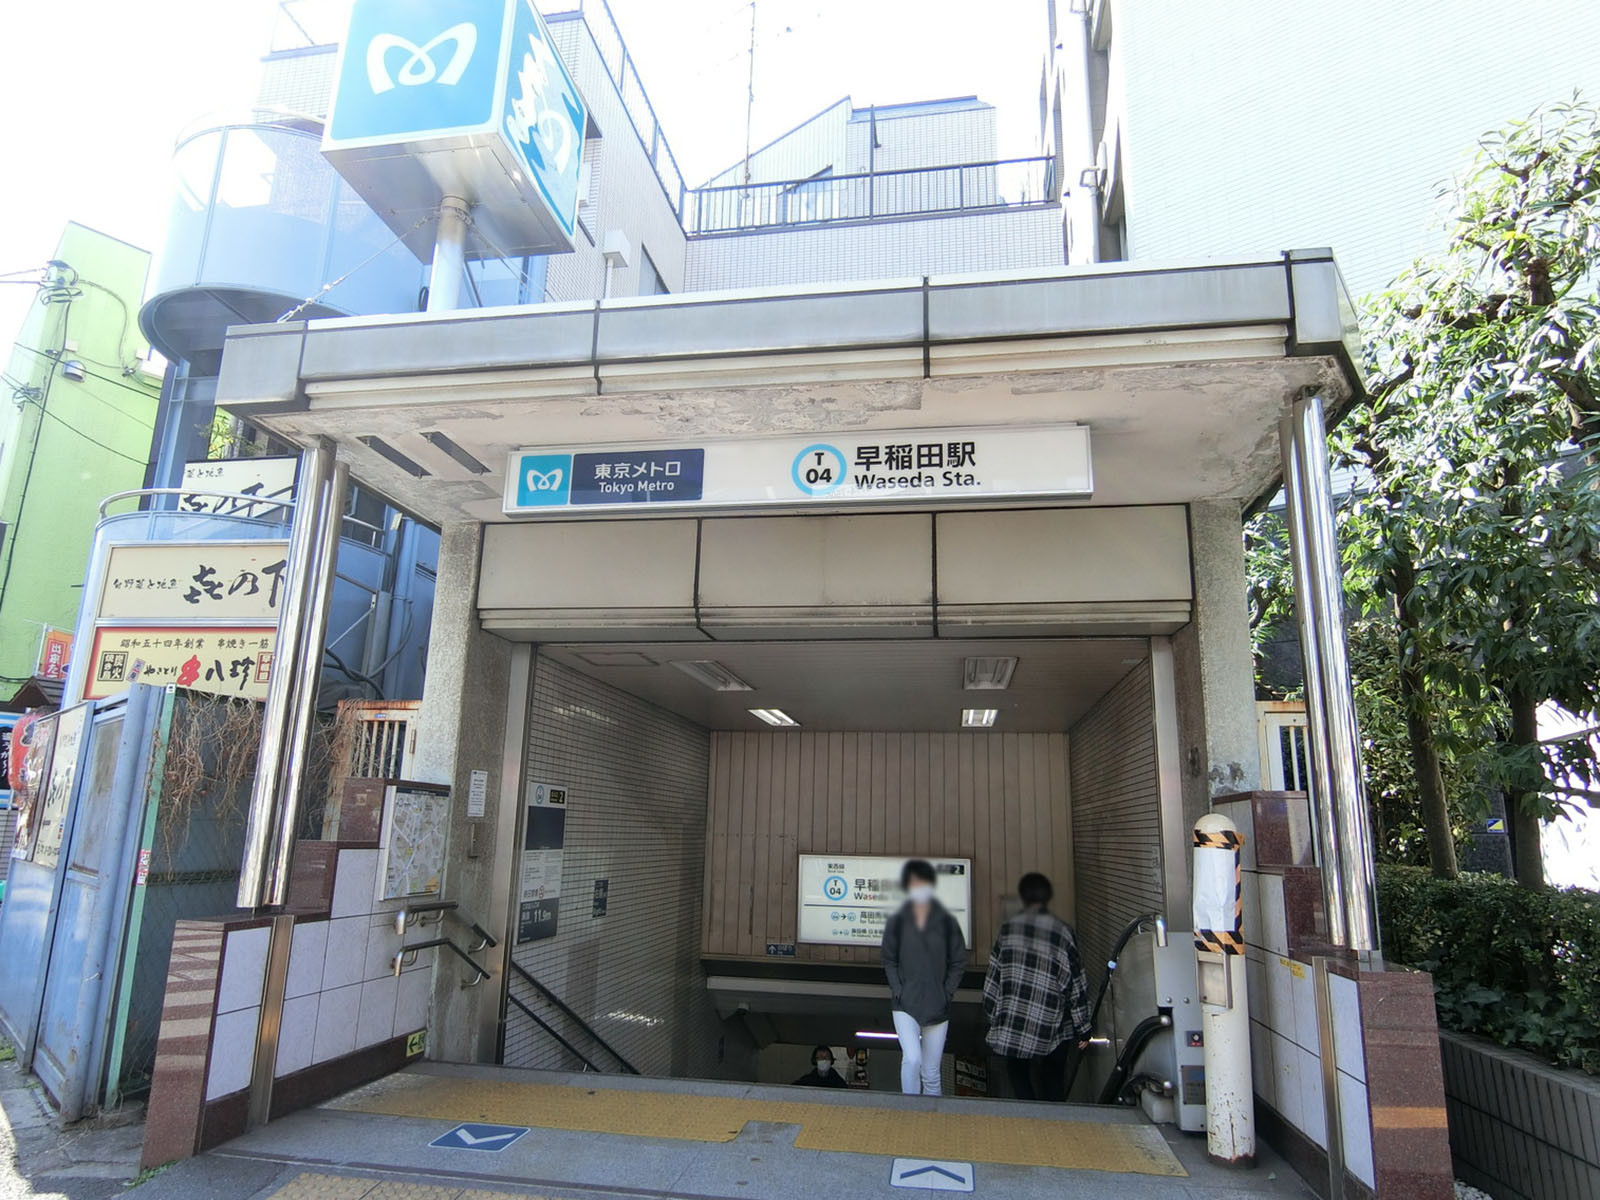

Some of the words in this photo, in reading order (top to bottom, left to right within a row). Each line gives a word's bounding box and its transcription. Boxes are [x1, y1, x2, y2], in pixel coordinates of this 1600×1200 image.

[814, 452, 825, 466] T
[854, 441, 976, 472] 早稲田駅
[593, 461, 681, 480] 東京メトロ
[805, 468, 832, 484] 04
[599, 481, 634, 496] Tokyo
[637, 480, 675, 493] Metro
[854, 471, 935, 490] Waseda
[942, 470, 981, 487] Sta.
[120, 638, 205, 649] 昭和五十四年創業
[217, 638, 269, 649] 串焼き一筋
[143, 664, 178, 677] やきとり
[829, 887, 842, 896] 04
